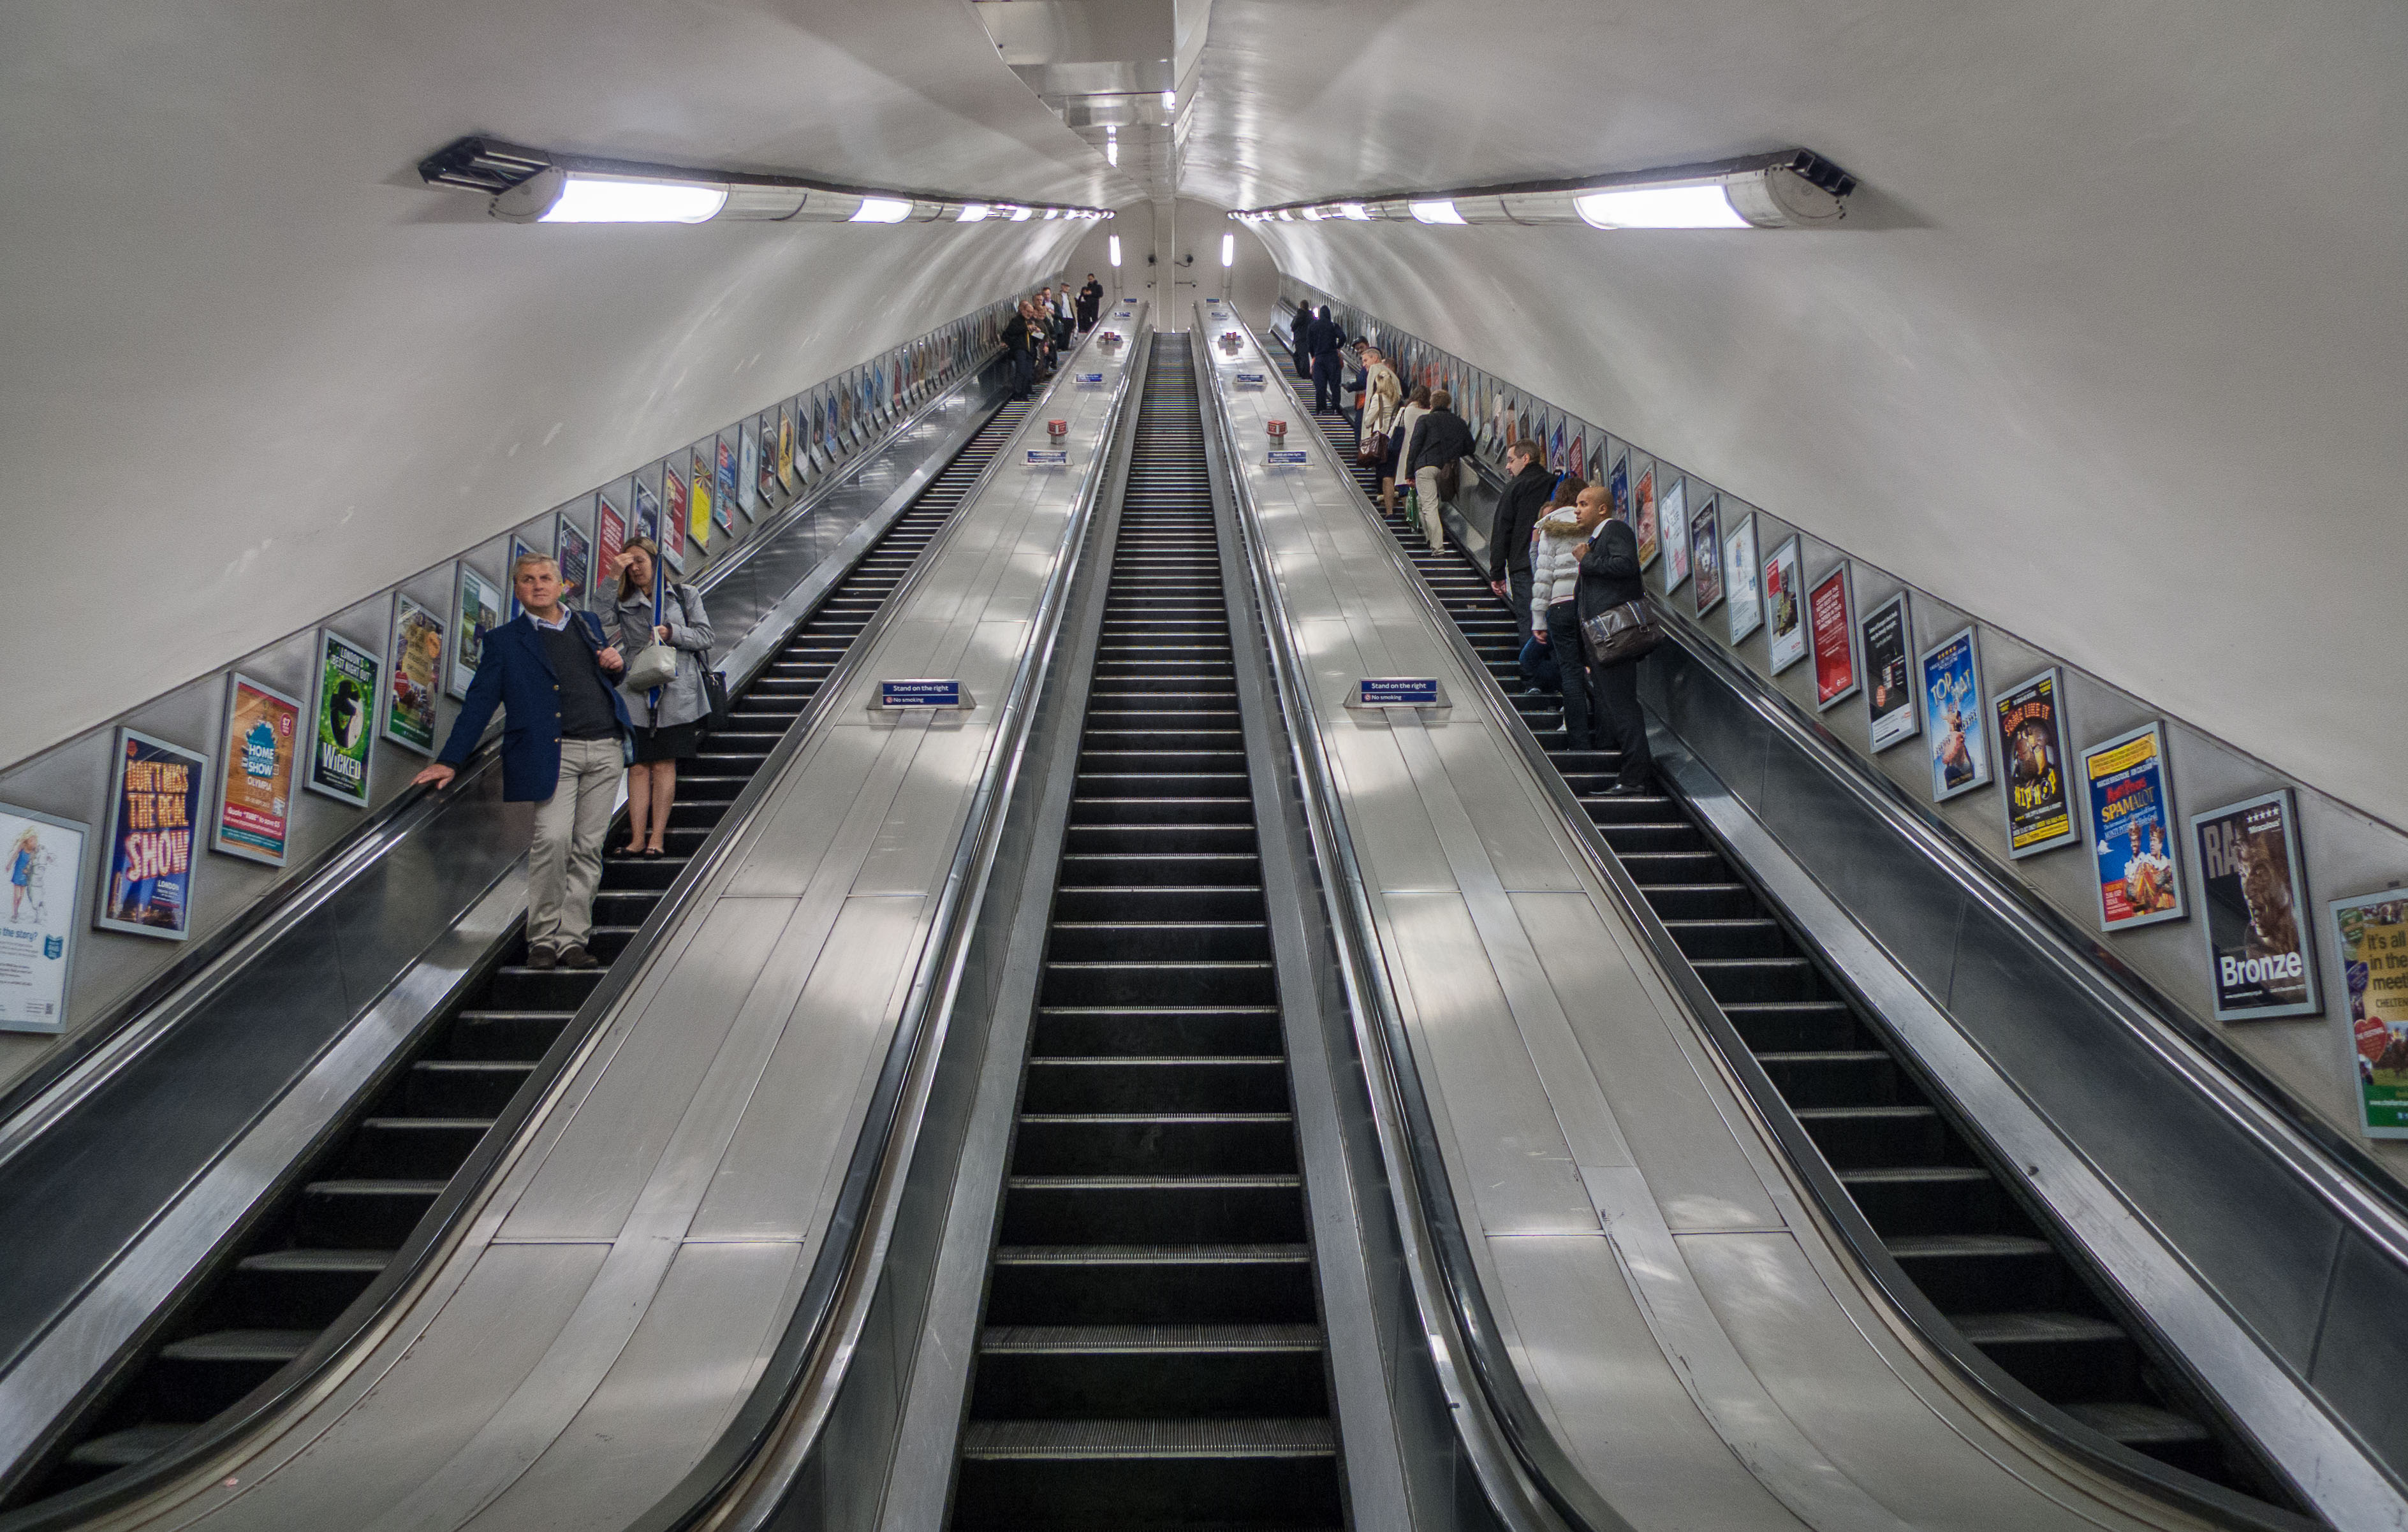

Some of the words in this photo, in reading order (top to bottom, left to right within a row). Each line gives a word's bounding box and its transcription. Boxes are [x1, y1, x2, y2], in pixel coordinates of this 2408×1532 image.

[1930, 671, 1952, 707] TOP
[1951, 668, 1972, 703] HAT
[2004, 706, 2023, 737] SOME
[2024, 701, 2041, 719] LIKE
[2041, 704, 2052, 720] IT
[248, 761, 274, 777] SHOW
[249, 744, 275, 760] HOME
[322, 741, 361, 780] WICKED
[126, 759, 161, 792] DON'T
[161, 764, 189, 794] MISS
[247, 776, 272, 791] OLYMPIA
[128, 792, 156, 829] THE
[158, 793, 189, 828] REAL
[2014, 785, 2031, 810] HIP
[2101, 785, 2155, 822] SPAMALOT
[124, 829, 189, 882] SHOW
[3, 927, 14, 938] the
[15, 930, 38, 942] story?
[2367, 934, 2388, 951] It's
[2391, 930, 2407, 948] all
[2220, 952, 2302, 987] Bronze
[2370, 954, 2382, 971] in
[2386, 952, 2408, 970] the
